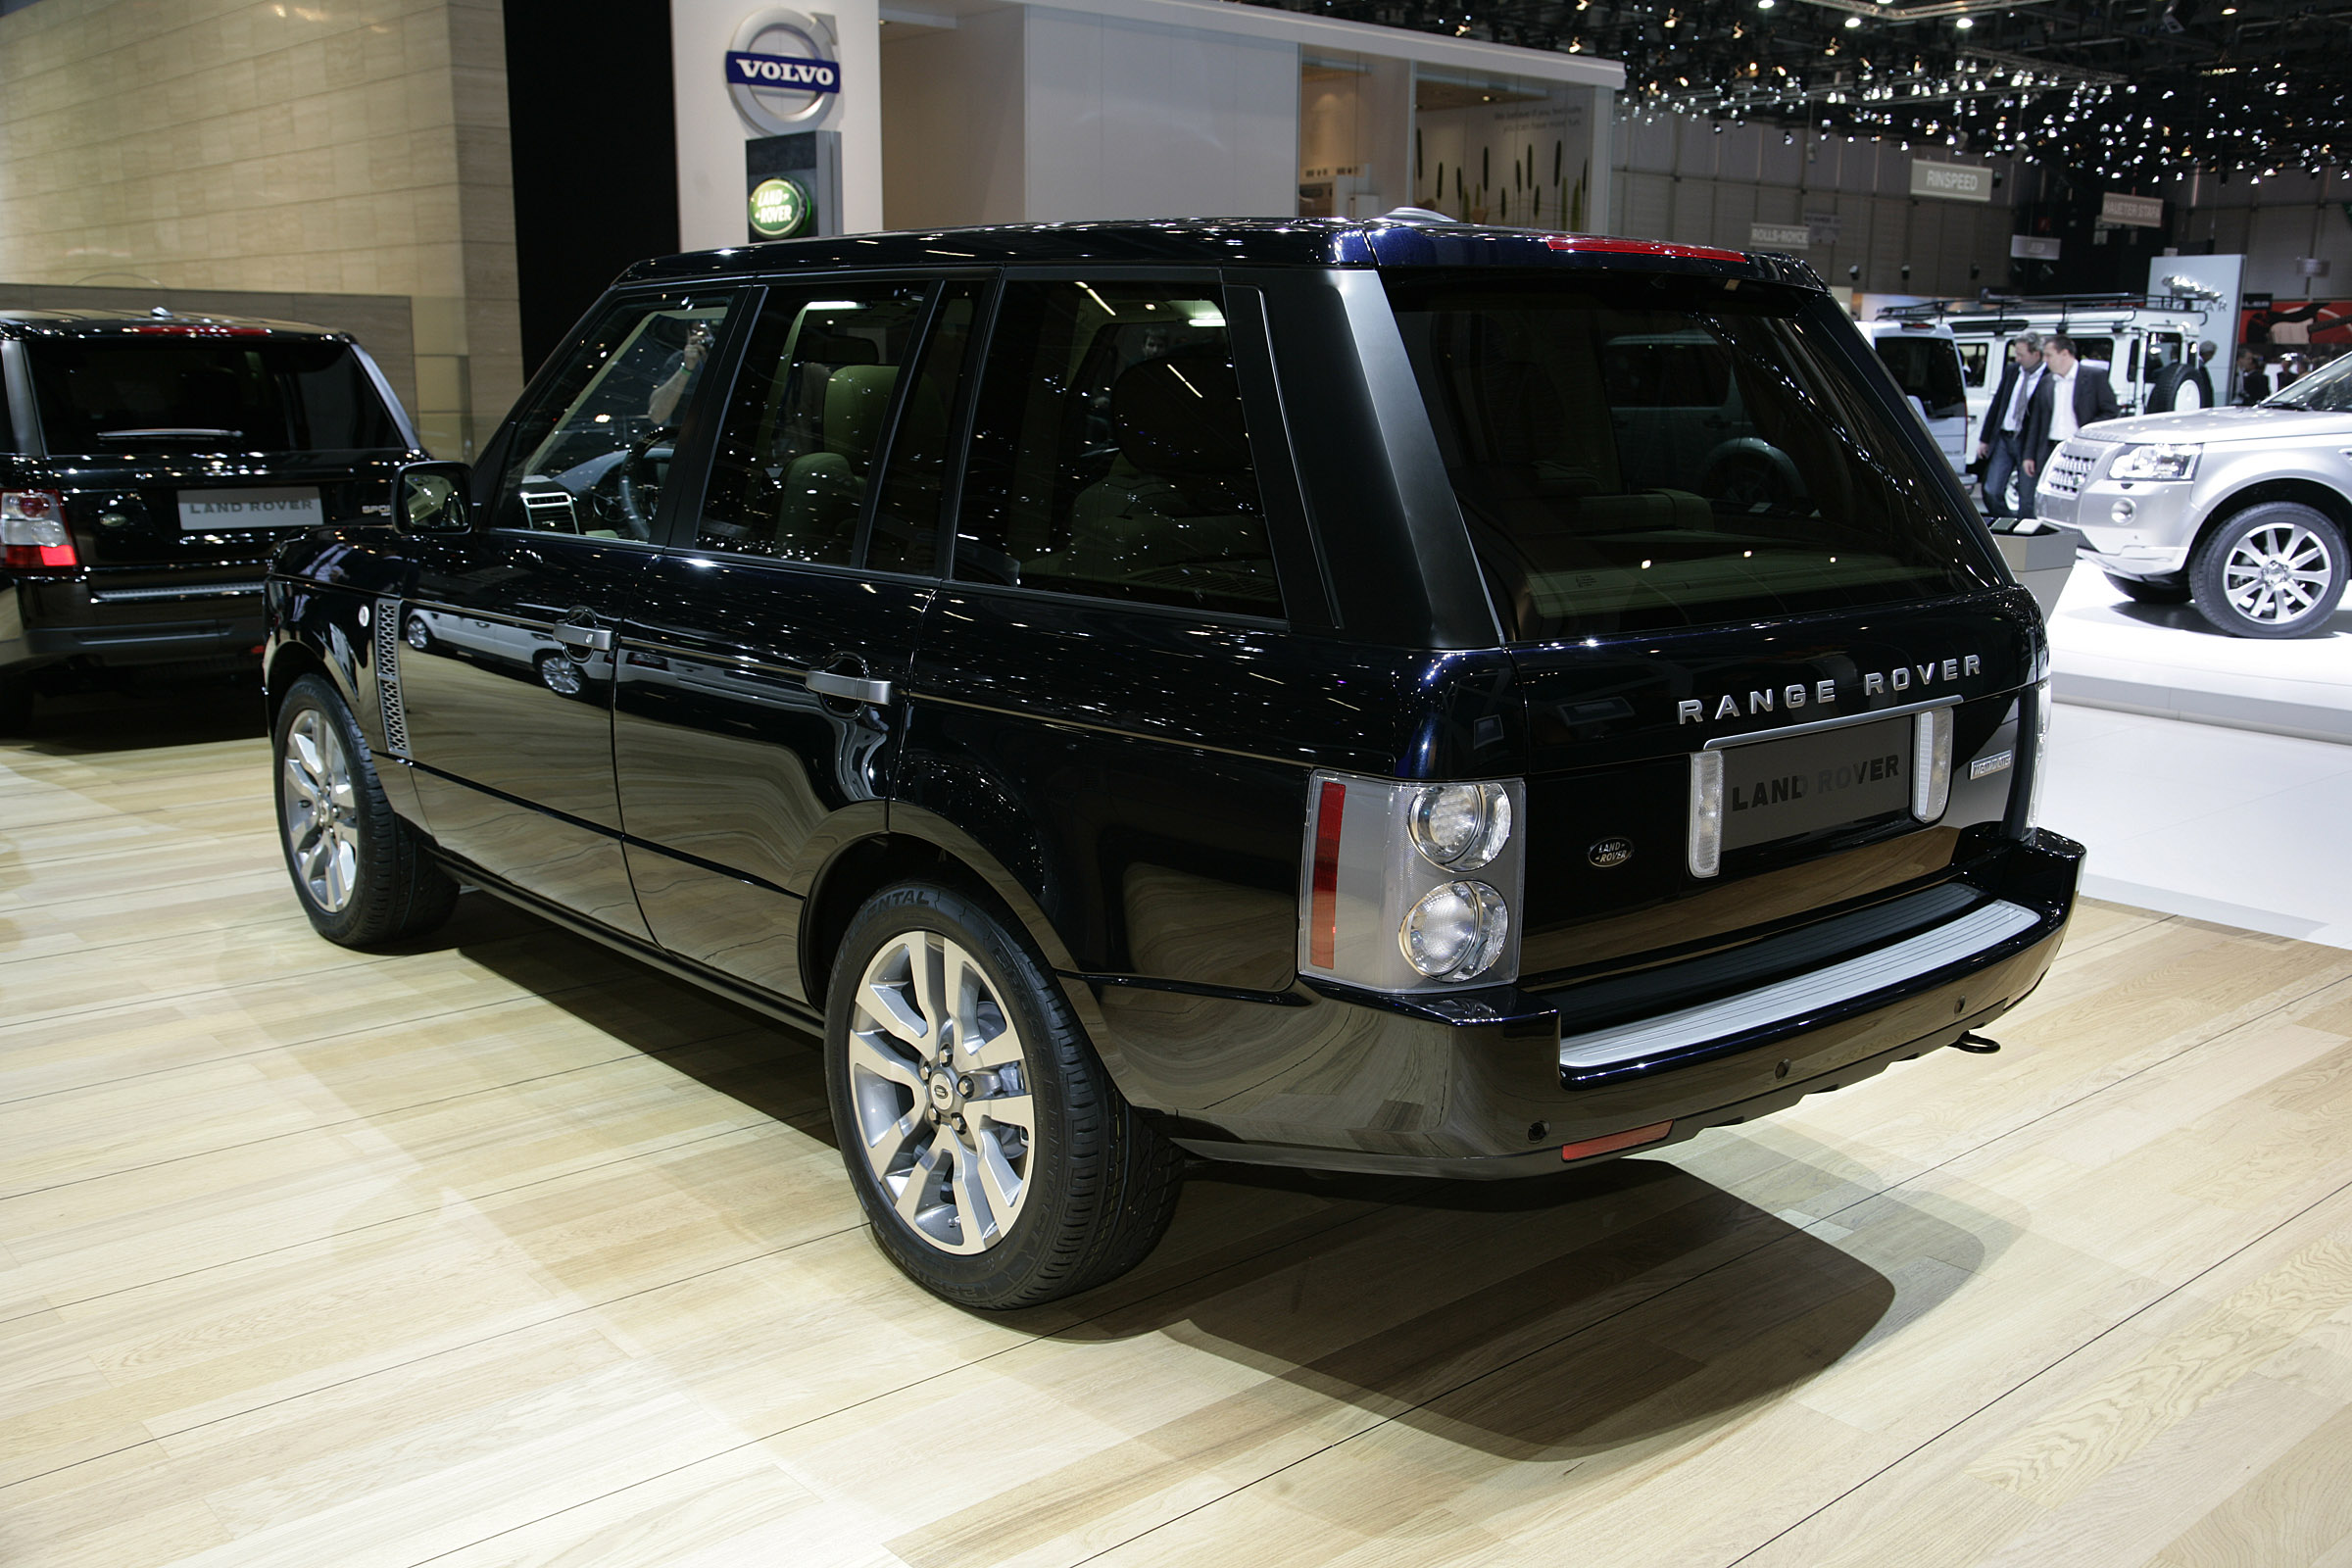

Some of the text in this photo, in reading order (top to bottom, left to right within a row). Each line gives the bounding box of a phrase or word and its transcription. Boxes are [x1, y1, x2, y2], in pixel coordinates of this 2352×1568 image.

[735, 58, 835, 86] VOLVO
[1926, 169, 1979, 191] RINSPEED
[757, 189, 784, 207] LAND
[760, 204, 793, 223] ROVER
[1751, 226, 1809, 244] ROLLS-ROYCE
[189, 498, 314, 515] LAND ROVER
[1677, 654, 1982, 726] RANGE ROVER
[1731, 753, 1900, 812] LAND ROVER
[1598, 842, 1621, 854] LAND
[1599, 850, 1628, 862] ROVER
